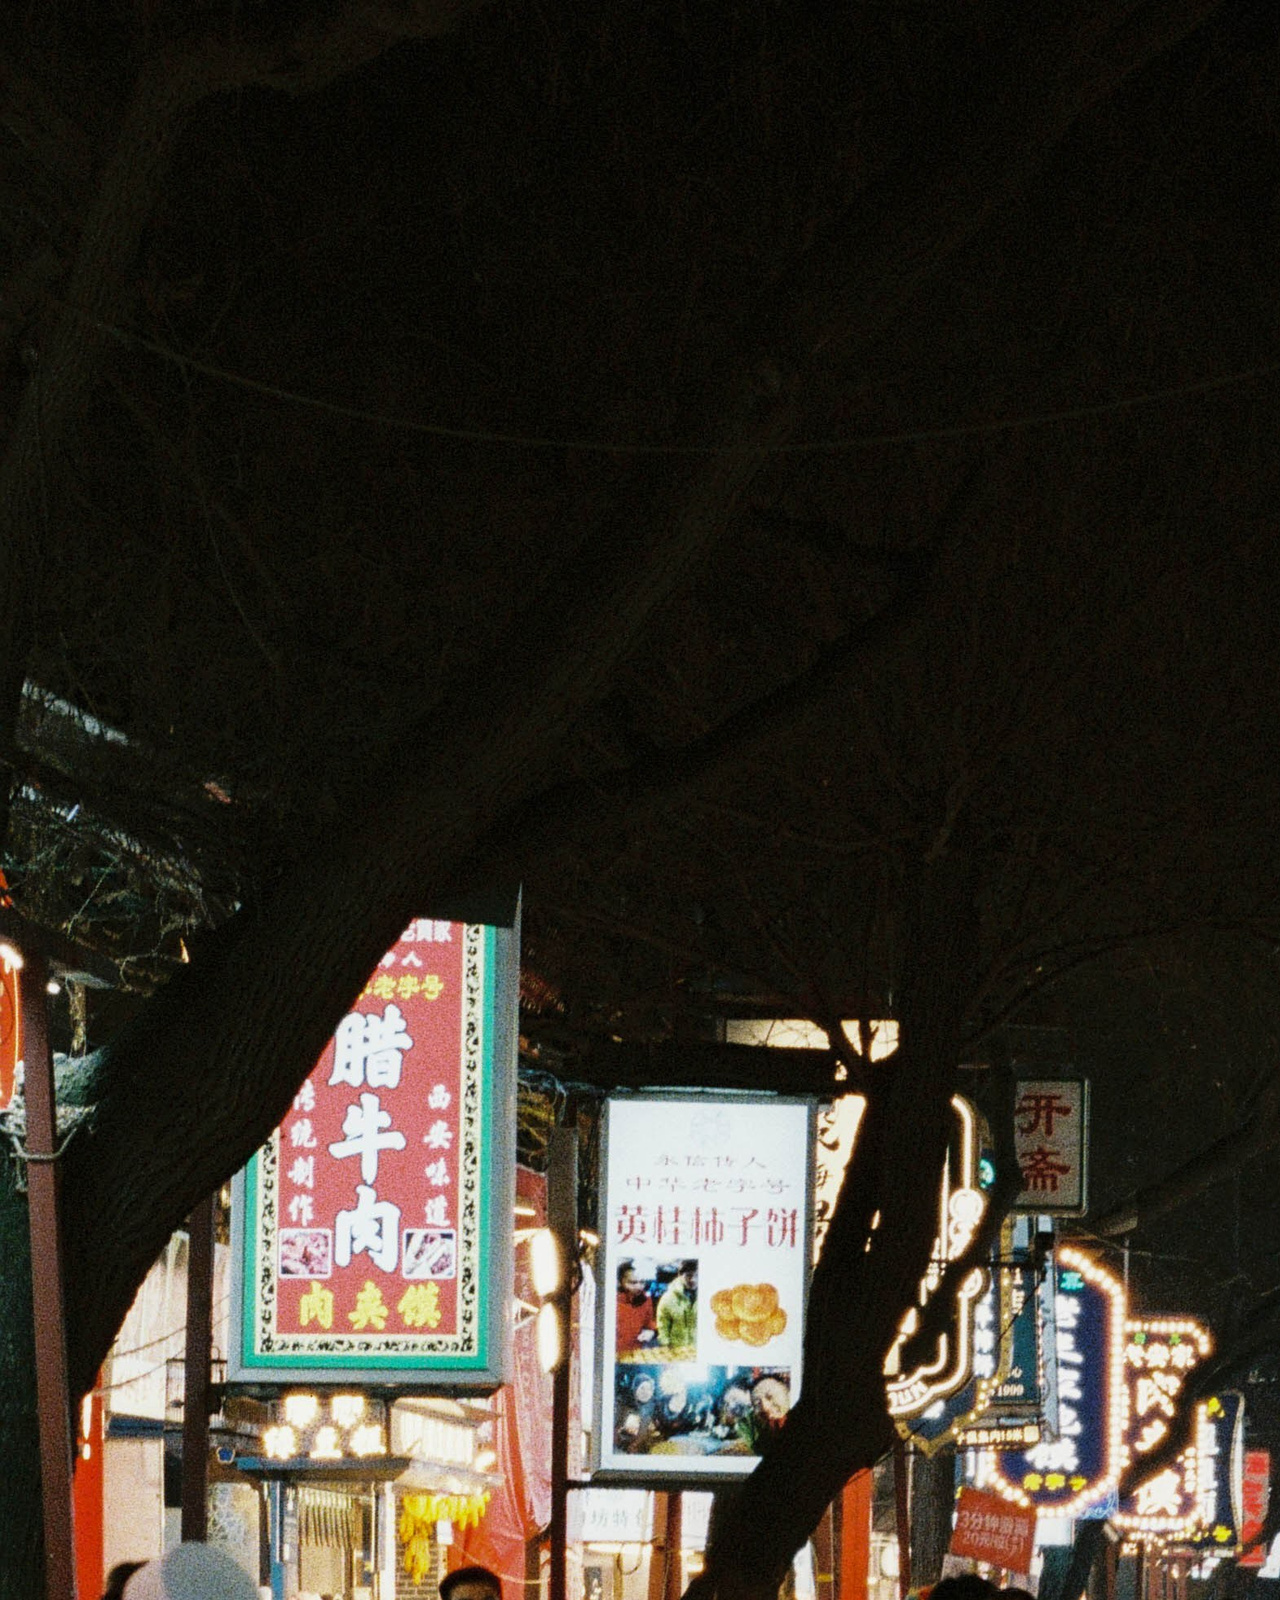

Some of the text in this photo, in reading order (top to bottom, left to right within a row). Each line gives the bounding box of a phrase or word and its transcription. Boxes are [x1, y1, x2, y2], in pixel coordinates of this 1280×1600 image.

[358, 974, 444, 1001] 老字号
[329, 1003, 414, 1272] 腊牛肉
[423, 1083, 453, 1227] 西安味道
[1015, 1093, 1072, 1193] 开斋
[299, 1279, 442, 1331] 肉夹馍
